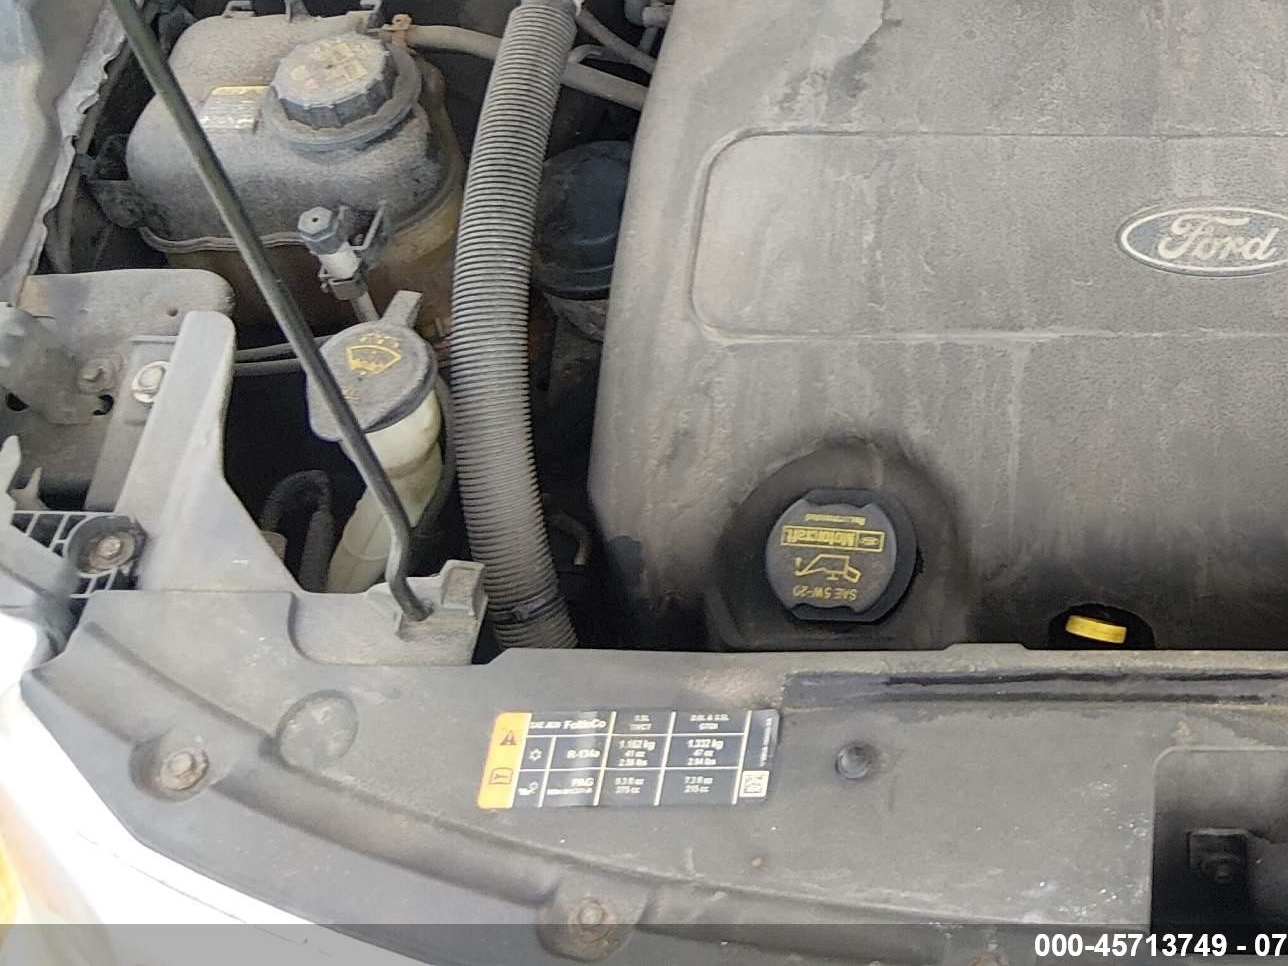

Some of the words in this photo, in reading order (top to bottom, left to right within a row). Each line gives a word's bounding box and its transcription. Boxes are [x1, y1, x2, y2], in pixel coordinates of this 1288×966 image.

[1157, 213, 1280, 261] Ford
[786, 528, 856, 547] Motorcraft
[793, 585, 832, 599] 5W-20
[832, 588, 857, 601] SAE
[572, 777, 594, 787] PAG
